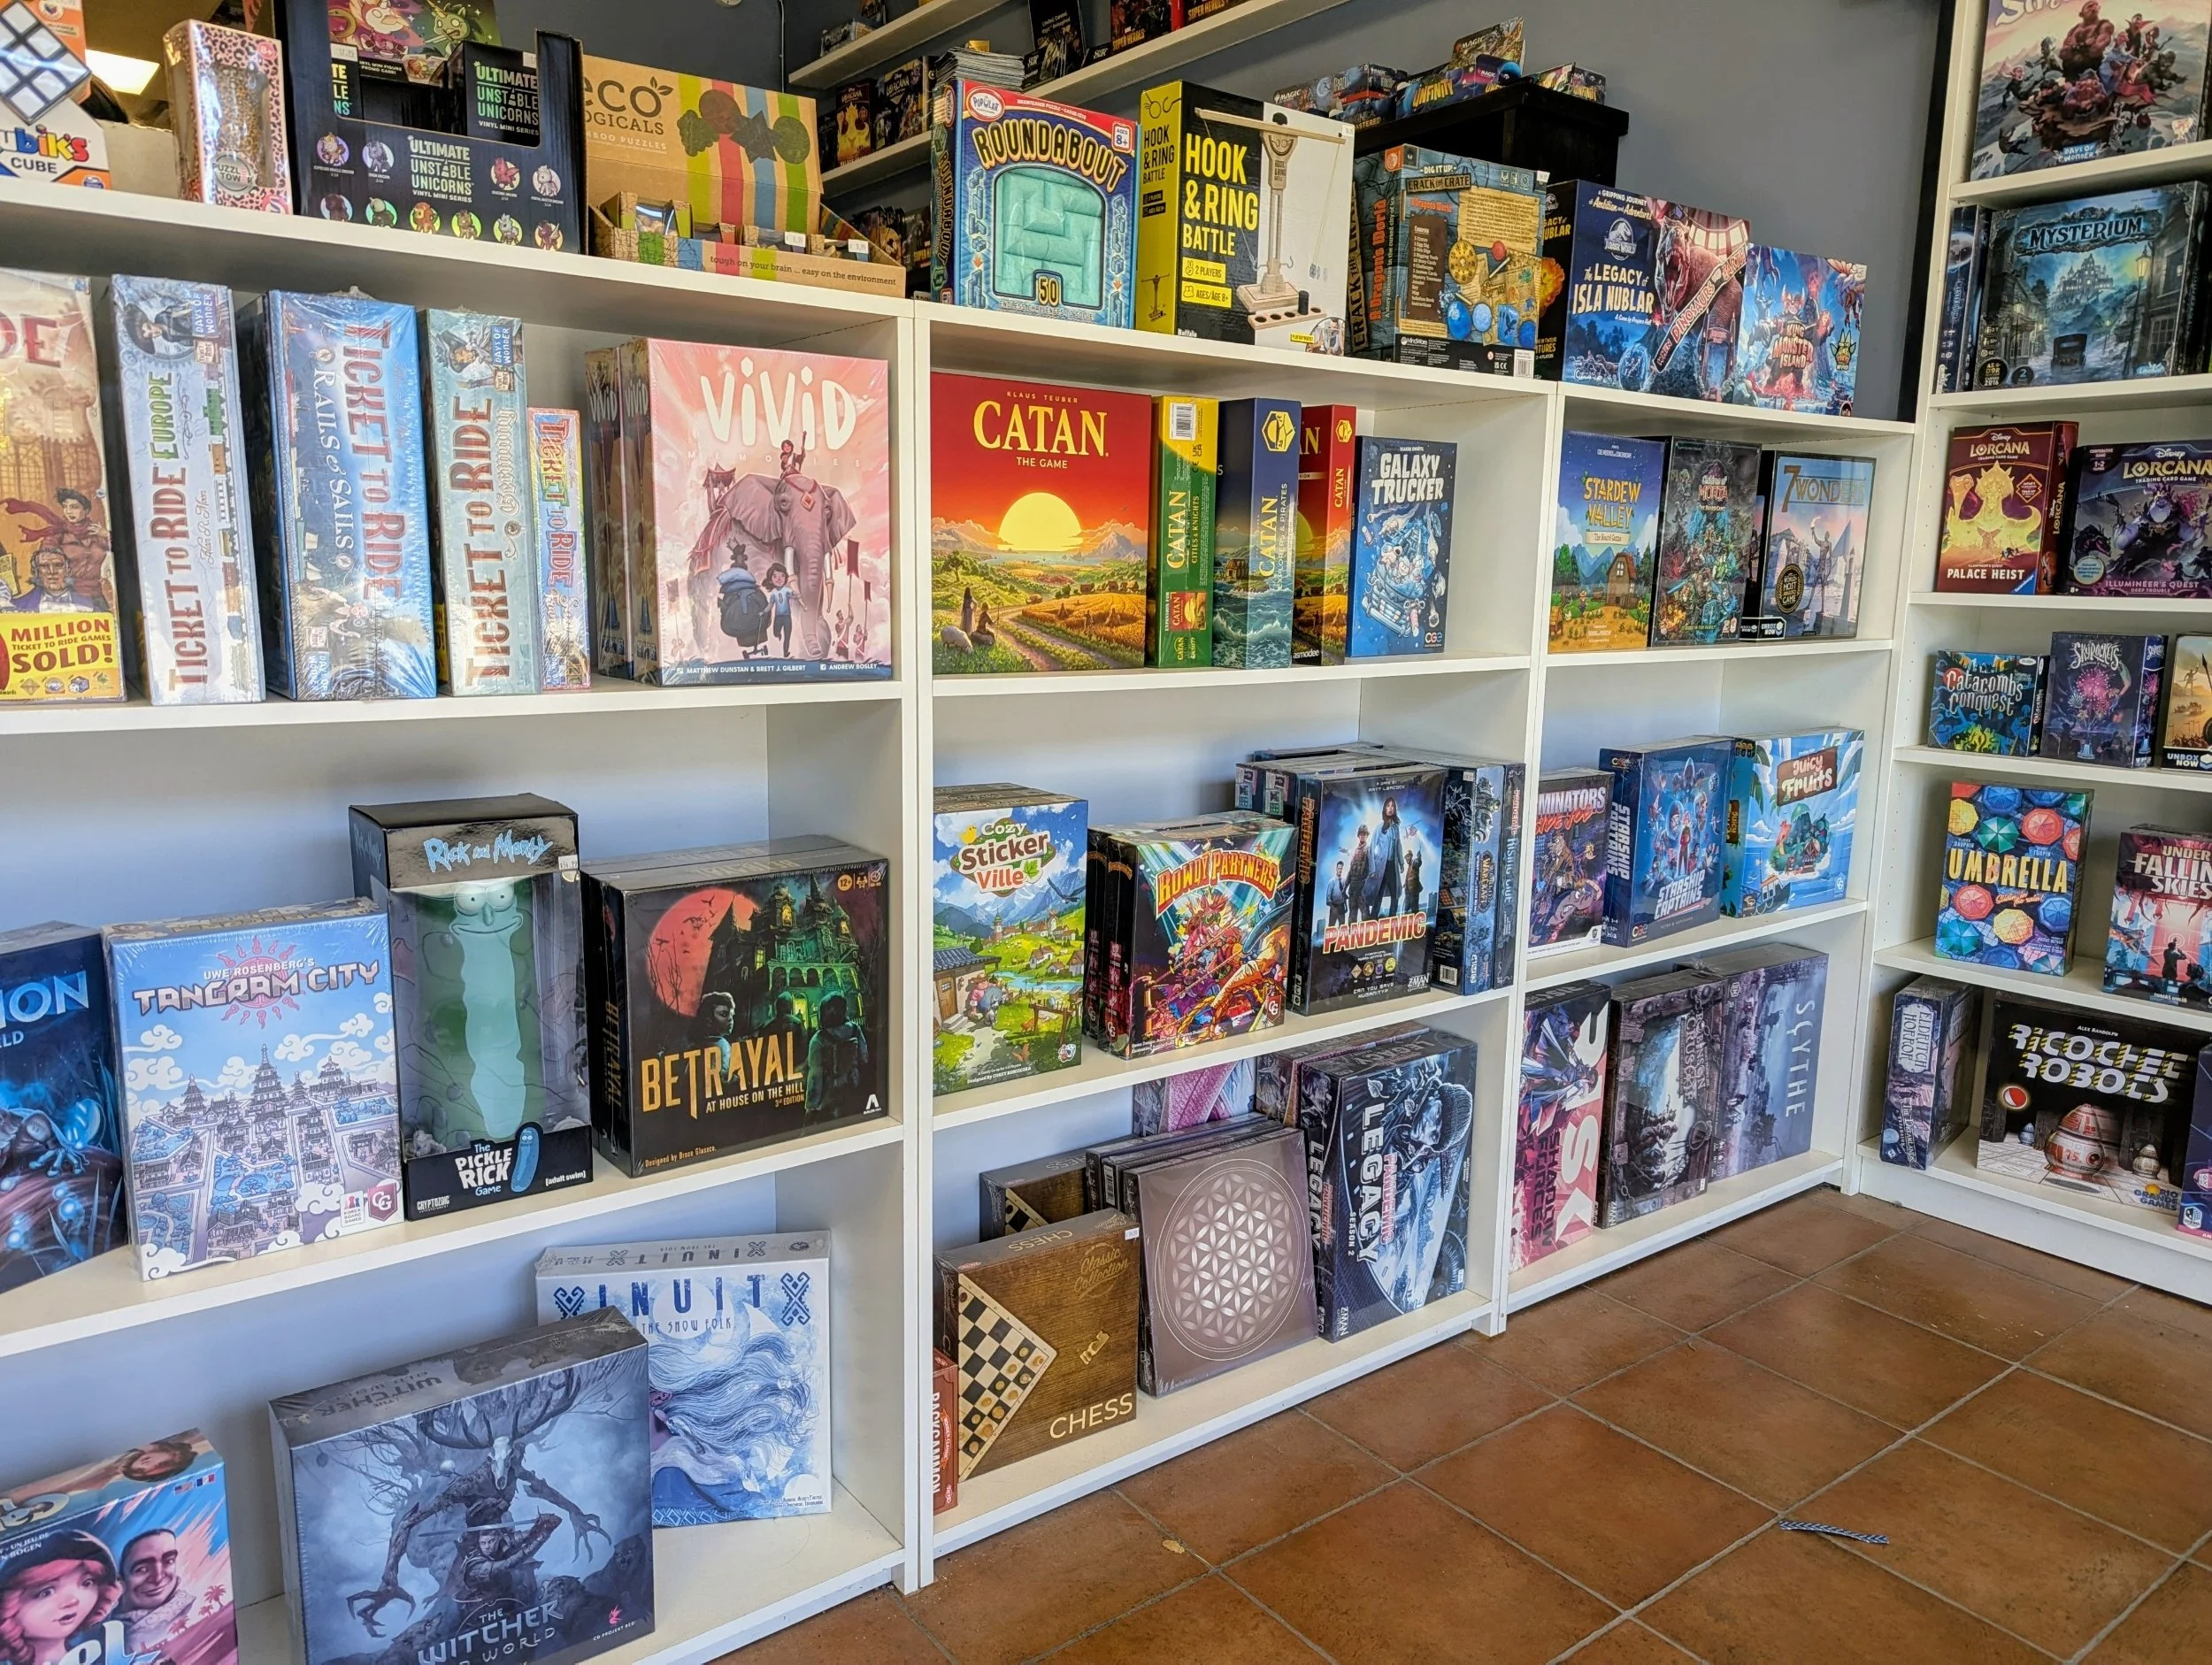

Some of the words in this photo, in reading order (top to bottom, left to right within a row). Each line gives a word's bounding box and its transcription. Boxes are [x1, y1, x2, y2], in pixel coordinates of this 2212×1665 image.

[1460, 35, 1486, 50] MAGIC
[476, 65, 538, 89] ULTIMATE
[1280, 88, 1302, 100] MAGIC
[1412, 79, 1455, 110] UNFINITY
[478, 102, 539, 126] UNICORNS
[479, 120, 498, 129] VINYL
[410, 138, 470, 160] ULTIMATE
[1116, 135, 1128, 147] 8+
[1143, 125, 1170, 149] HOOK
[11, 157, 58, 173] CUBE
[972, 118, 1126, 194] ROUNDABOUT
[1143, 150, 1151, 170] &
[1152, 145, 1175, 166] RING
[1185, 133, 1248, 185] HOOK
[411, 175, 472, 196] UNICORNS
[1143, 168, 1165, 184] BATTLE
[1408, 180, 1434, 190] CRACK
[1445, 176, 1470, 187] CRATE
[412, 189, 430, 198] VINYL
[1185, 180, 1201, 219] &
[1205, 183, 1258, 230] RING
[1182, 224, 1237, 257] BATTLE
[2030, 218, 2142, 249] MYSTERIUM
[710, 256, 735, 267] tough
[750, 261, 769, 272] your
[771, 263, 792, 273] brain
[802, 267, 818, 278] easy
[833, 271, 845, 280] the
[847, 273, 896, 286] environment
[1202, 265, 1222, 279] PLAYERS
[1037, 275, 1059, 306] 50
[1573, 284, 1601, 314] ISLA
[1606, 285, 1655, 314] NUBLAR
[204, 293, 216, 335] WONDER
[1786, 321, 1806, 339] KING
[502, 326, 512, 367] WONDER
[1772, 337, 1814, 359] MONSTER
[1779, 354, 1807, 369] ISLAND
[343, 318, 393, 464] TICKET
[1007, 390, 1036, 400] KLAUS
[1043, 395, 1078, 403] TEUBER
[148, 371, 181, 459] EUROPE
[973, 401, 1107, 457] CATAN
[450, 395, 494, 493] RIDE
[1970, 441, 2030, 457] LORCANA
[1991, 433, 2011, 441] Disney
[496, 409, 521, 517] Germany
[1017, 457, 1036, 467] THE
[1040, 459, 1068, 469] GAME
[1380, 452, 1440, 480] GALAXY
[2154, 448, 2185, 459] Disney
[2124, 460, 2212, 479] LORCANA
[360, 469, 391, 503] TO
[1334, 468, 1345, 508] CATAN
[1371, 477, 1445, 505] TRUCKER
[1584, 477, 1642, 503] STARDEW
[1784, 464, 1801, 513] 7
[1796, 479, 1864, 503] WONDERS
[150, 466, 188, 541] RIDE
[1588, 503, 1632, 529] VALLEY
[2053, 481, 2065, 534] LORCANA
[465, 500, 494, 538] TO
[1166, 490, 1187, 569] CATAN
[1259, 496, 1278, 577] CATAN
[167, 545, 189, 571] TO
[361, 510, 409, 601] RIDE
[1947, 569, 1989, 579] PALACE
[1992, 570, 2024, 580] HEIST
[464, 542, 511, 689] TICKET
[12, 619, 110, 641] MILLION
[58, 637, 78, 646] RIDE
[161, 576, 209, 691] TICKET
[12, 644, 113, 673] SOLD!
[1293, 648, 1319, 660] asmodee
[687, 665, 719, 674] MATTHEW
[2167, 753, 2200, 763] UNBOX
[980, 820, 1027, 837] Cozy
[1301, 796, 1316, 884] PANDEMIC
[1618, 804, 1631, 880] STARSHIP
[958, 832, 1048, 871] Sticker
[2162, 845, 2210, 861] UNDER
[974, 866, 1025, 890] Ville
[1157, 862, 1209, 916] ROWDY
[1210, 848, 1281, 901] PARTNERS
[1948, 848, 2067, 894] UMBRELLA
[1659, 870, 1706, 901] STARSHIP
[2151, 877, 2212, 900] SKIES
[1654, 884, 1703, 921] CAPTAINS
[1323, 911, 1426, 954] PANDEMIC
[203, 969, 230, 981] UWE
[233, 957, 314, 978] ROSENBERG'S
[132, 974, 301, 1017] TANGRAM
[306, 961, 380, 994] CITY
[1915, 1012, 1932, 1069] ELDRITCH
[641, 1032, 804, 1120] BETRAYAL
[706, 1101, 717, 1113] AT
[719, 1094, 749, 1109] HOUSE
[752, 1092, 764, 1104] ON
[767, 1086, 783, 1101] THE
[785, 1081, 804, 1096] HILL
[455, 1147, 512, 1171] PICKLE
[474, 1143, 490, 1154] The
[458, 1161, 511, 1189] RICK
[1356, 1101, 1386, 1264] LEGACY
[1532, 1134, 1547, 1240] FORCES
[1542, 1130, 1561, 1247] SHADOW
[475, 1185, 501, 1196] Game
[1379, 1152, 1399, 1245] PANDEMIC
[2139, 1198, 2178, 1211] GAMES
[1008, 1230, 1073, 1253] CHESS
[1074, 1257, 1130, 1293] Collection
[1080, 1248, 1121, 1275] Classic
[598, 1273, 766, 1316] INUIT
[641, 1317, 661, 1334] THE
[668, 1320, 698, 1332] SNOW
[706, 1316, 732, 1330] FOLK
[1049, 1393, 1133, 1439] CHESS
[479, 1607, 503, 1623] THE
[417, 1598, 565, 1665] WITCHER
[481, 1627, 556, 1662] WORLD
